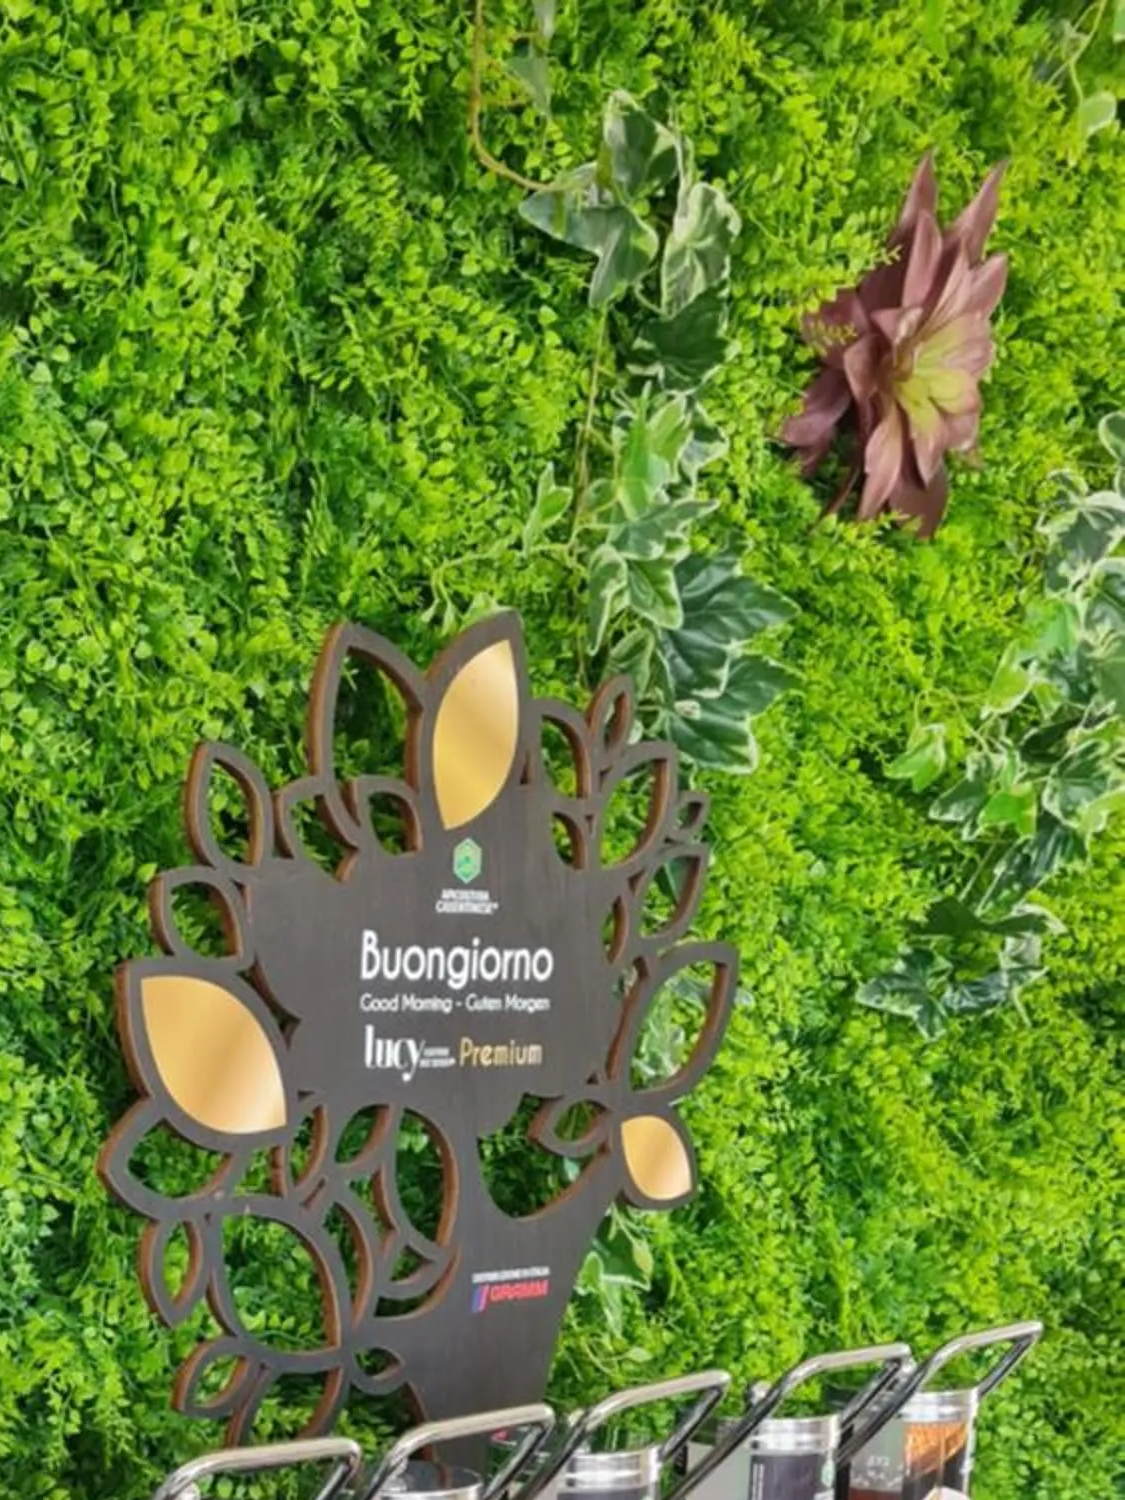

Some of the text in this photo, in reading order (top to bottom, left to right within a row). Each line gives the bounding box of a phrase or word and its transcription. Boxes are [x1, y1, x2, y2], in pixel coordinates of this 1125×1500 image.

[360, 929, 554, 989] Buongiorno
[360, 993, 399, 1011] Good
[402, 994, 453, 1014] Morning
[465, 993, 502, 1011] Guten
[505, 994, 550, 1014] Morgen
[365, 1024, 425, 1082] lucy
[459, 1036, 542, 1066] Premium
